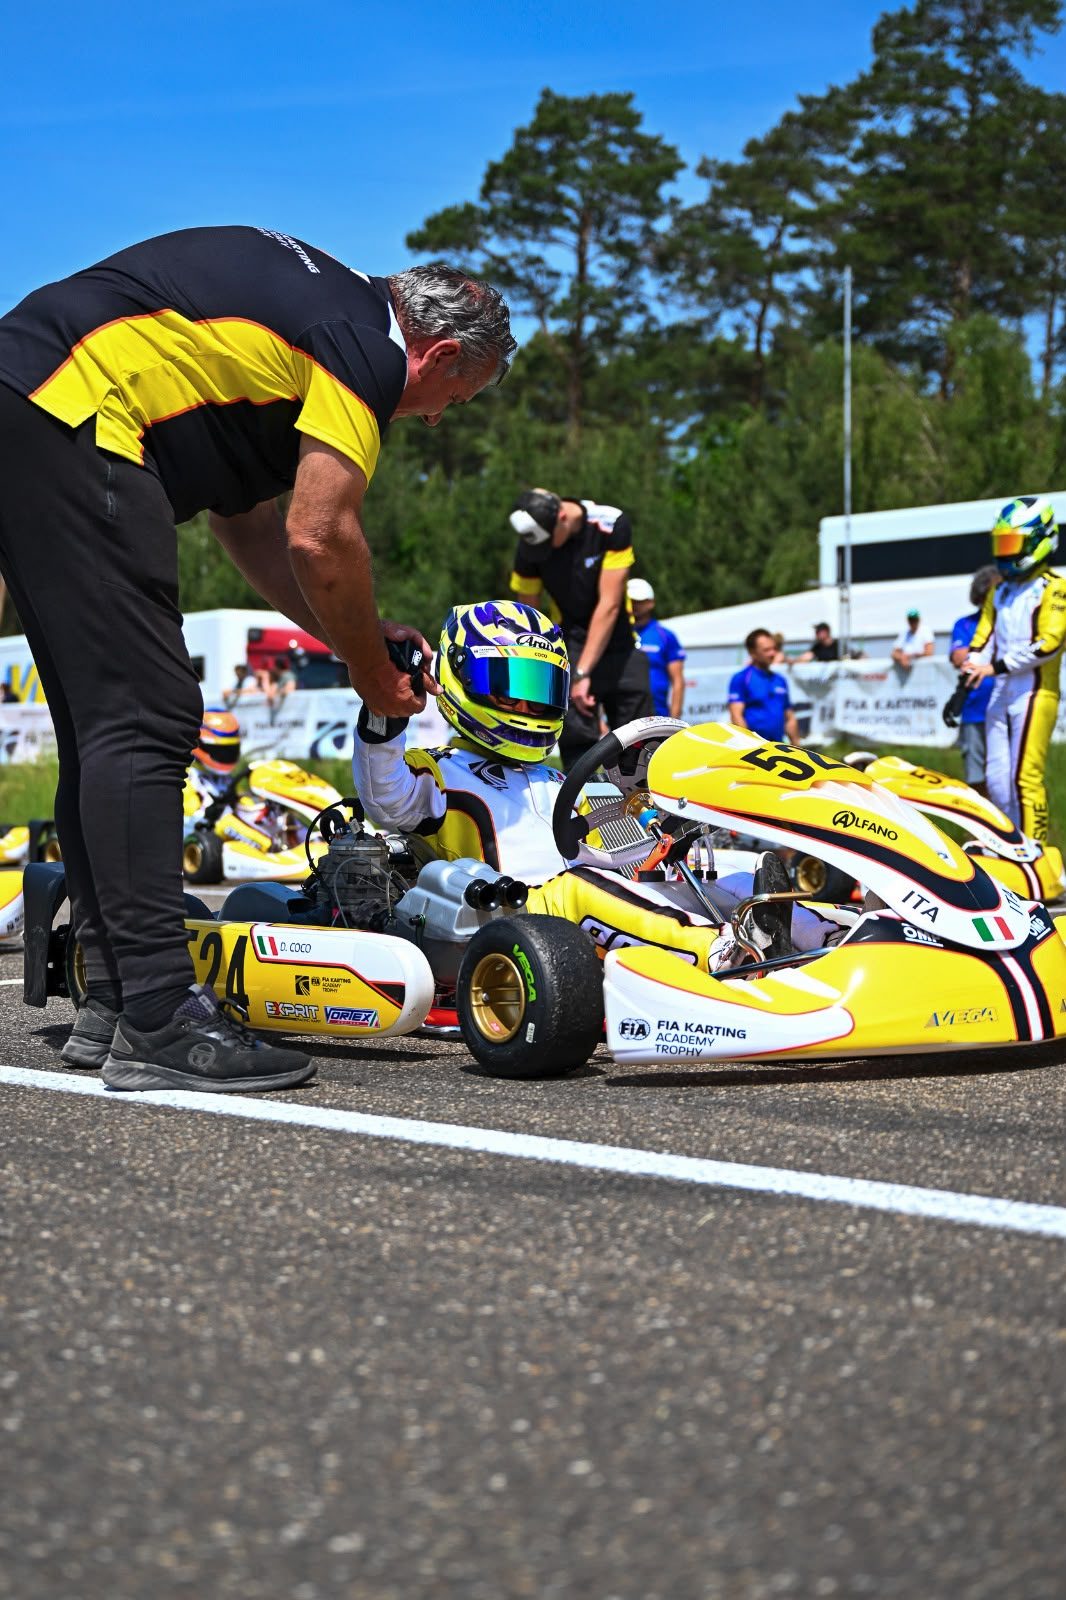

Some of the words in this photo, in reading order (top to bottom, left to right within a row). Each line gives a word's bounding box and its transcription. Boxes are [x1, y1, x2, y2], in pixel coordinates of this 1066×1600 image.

[521, 636, 550, 651] Arai
[874, 697, 937, 710] KARTING
[832, 810, 899, 842] ALFANO
[1033, 803, 1048, 841] SWE
[902, 890, 940, 924] ITA
[279, 941, 288, 952] D.
[289, 942, 312, 954] COCO
[513, 943, 537, 1002] VEGA
[265, 1001, 320, 1019] EXPRIT
[324, 1006, 373, 1023] VORTEX
[924, 1006, 999, 1028] VEGA
[657, 1020, 680, 1031] FIA
[684, 1022, 747, 1039] KARTING
[655, 1032, 715, 1047] ACADEMY
[655, 1044, 703, 1057] TROPHY
